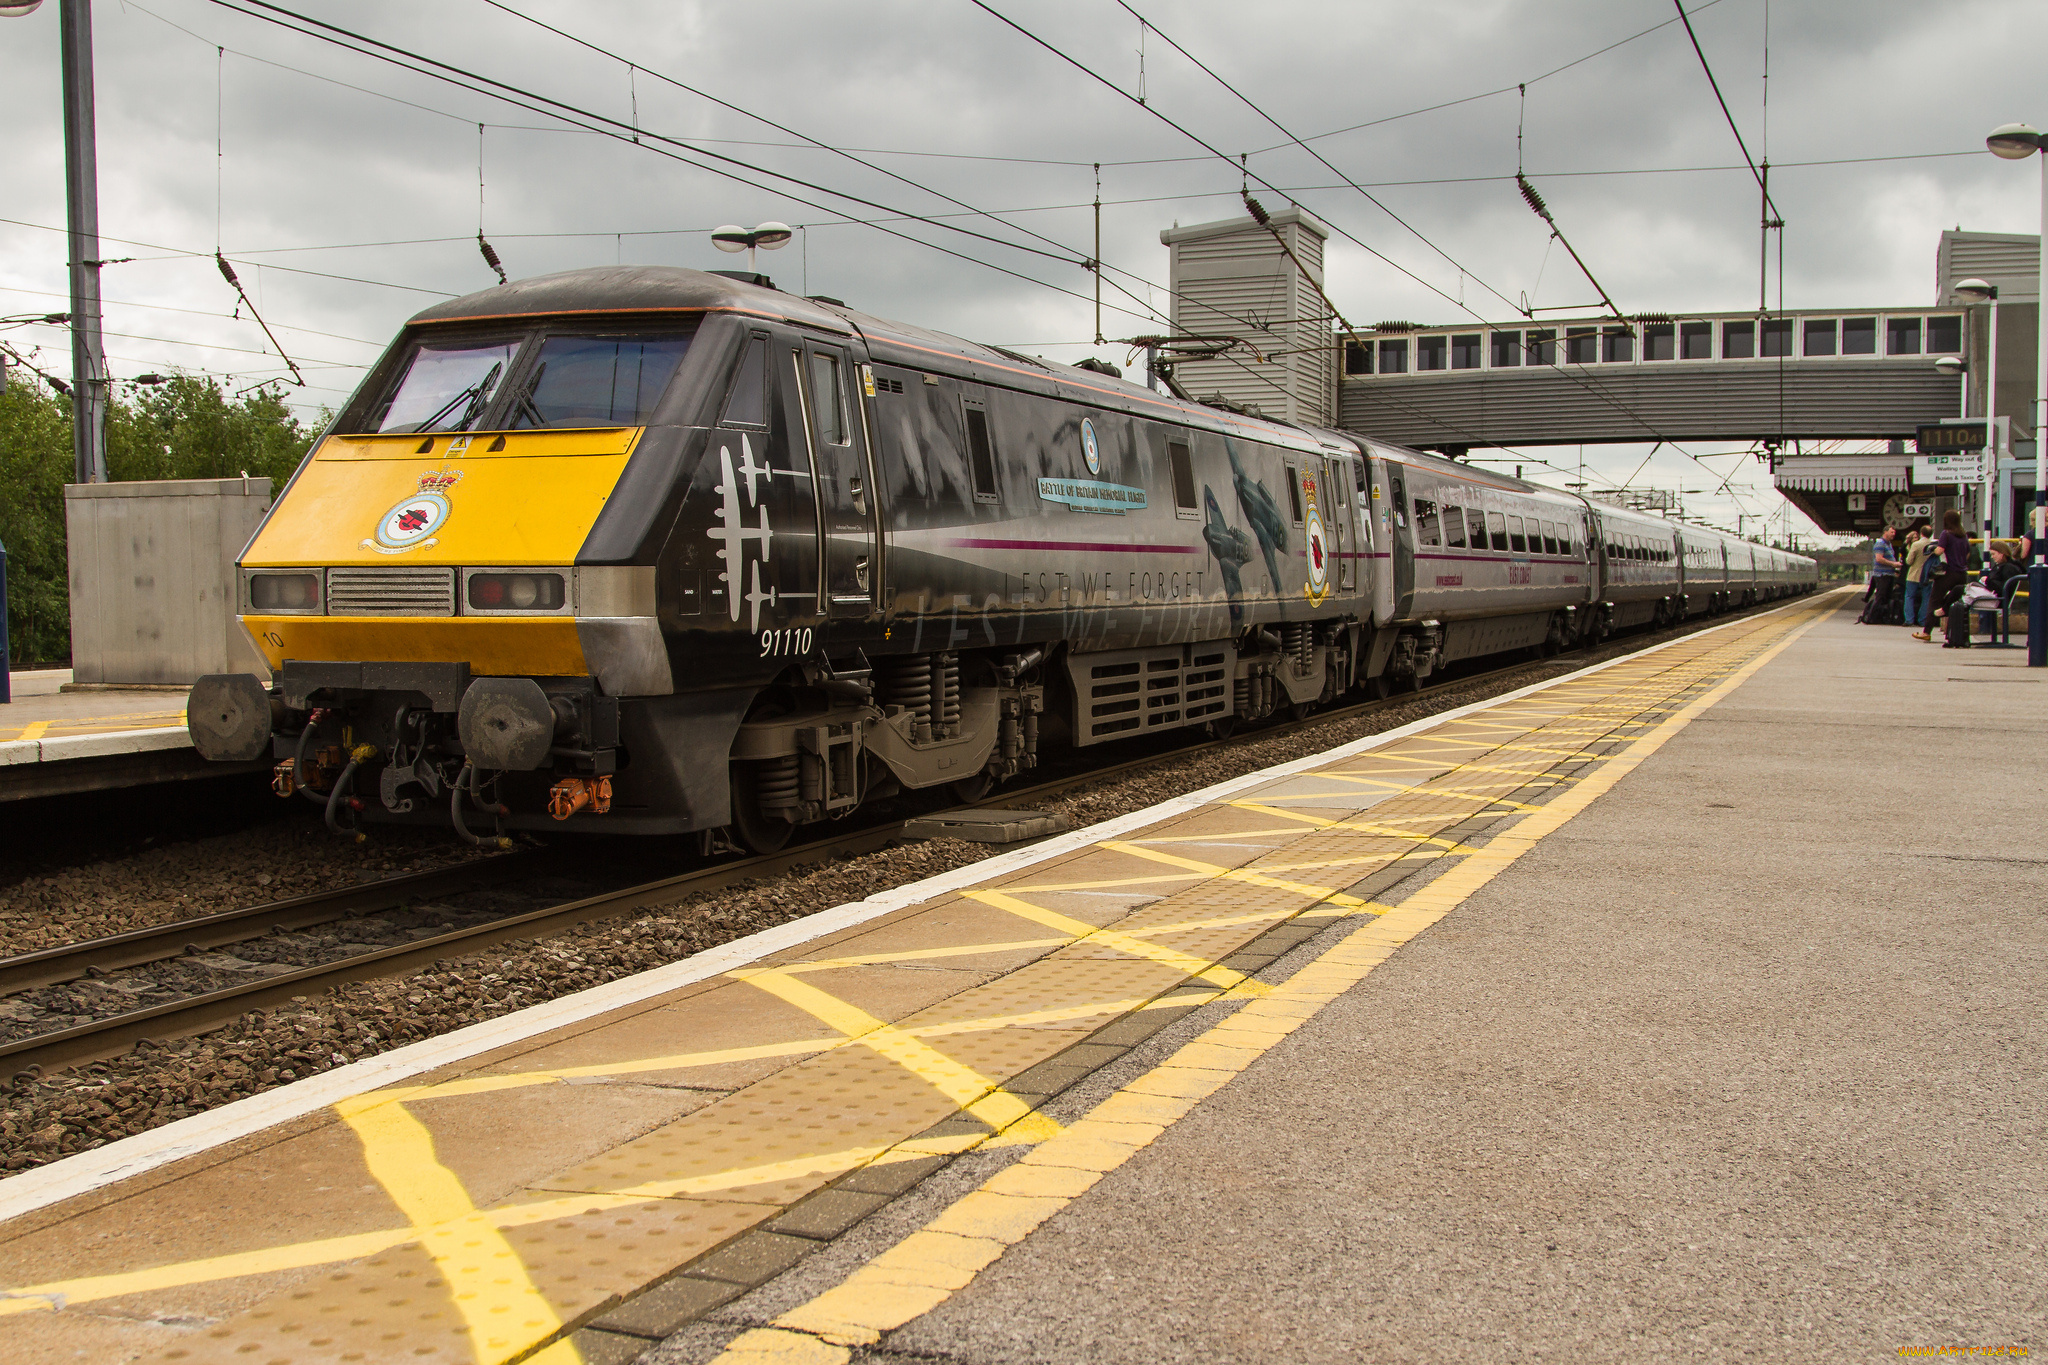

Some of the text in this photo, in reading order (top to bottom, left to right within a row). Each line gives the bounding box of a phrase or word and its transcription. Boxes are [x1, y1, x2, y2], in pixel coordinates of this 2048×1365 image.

[1041, 482, 1146, 504] BATTLE OF BRITAIN MEMORIAL FLIGHT
[1853, 497, 1859, 508] 1
[1082, 572, 1112, 601] WE
[1129, 571, 1204, 600] FORGET
[263, 632, 284, 647] 10
[760, 628, 812, 658] 91110
